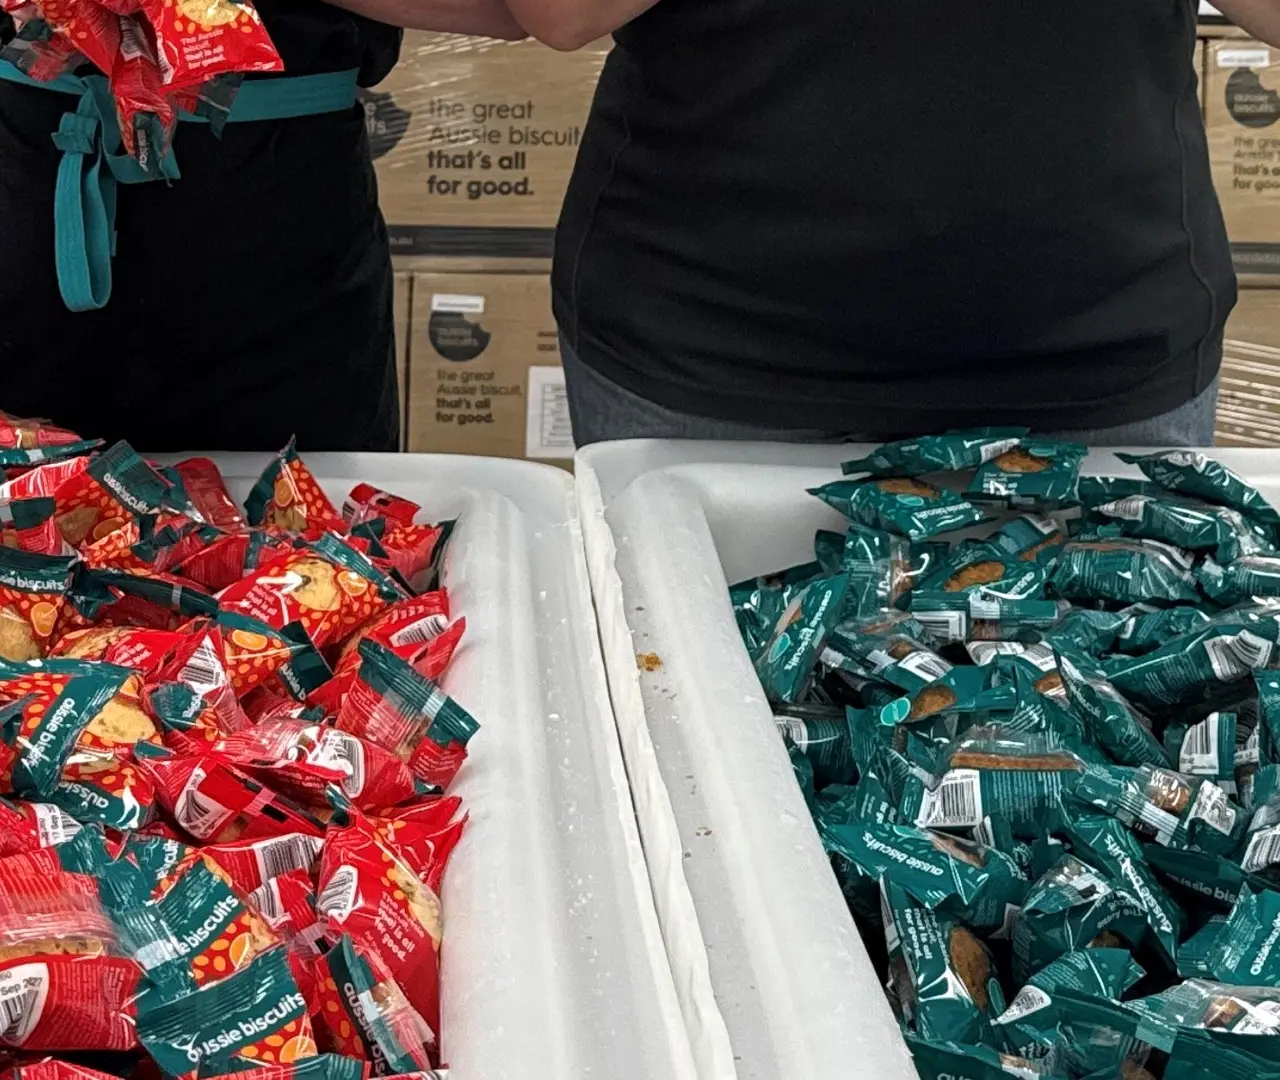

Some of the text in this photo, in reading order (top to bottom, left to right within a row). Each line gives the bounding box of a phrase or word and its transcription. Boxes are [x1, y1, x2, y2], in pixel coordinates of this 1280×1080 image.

[429, 99, 534, 123] the great
[429, 126, 581, 146] Aussie biscuit
[427, 151, 526, 170] that's all
[427, 175, 535, 200] for good.
[436, 397, 491, 409] that's all
[436, 411, 455, 423] for
[17, 576, 66, 592] biscuits
[861, 830, 944, 877] aussie biscuits
[188, 893, 240, 952] biscuits
[0, 982, 23, 999] Sep
[241, 991, 306, 1037] biscuits
